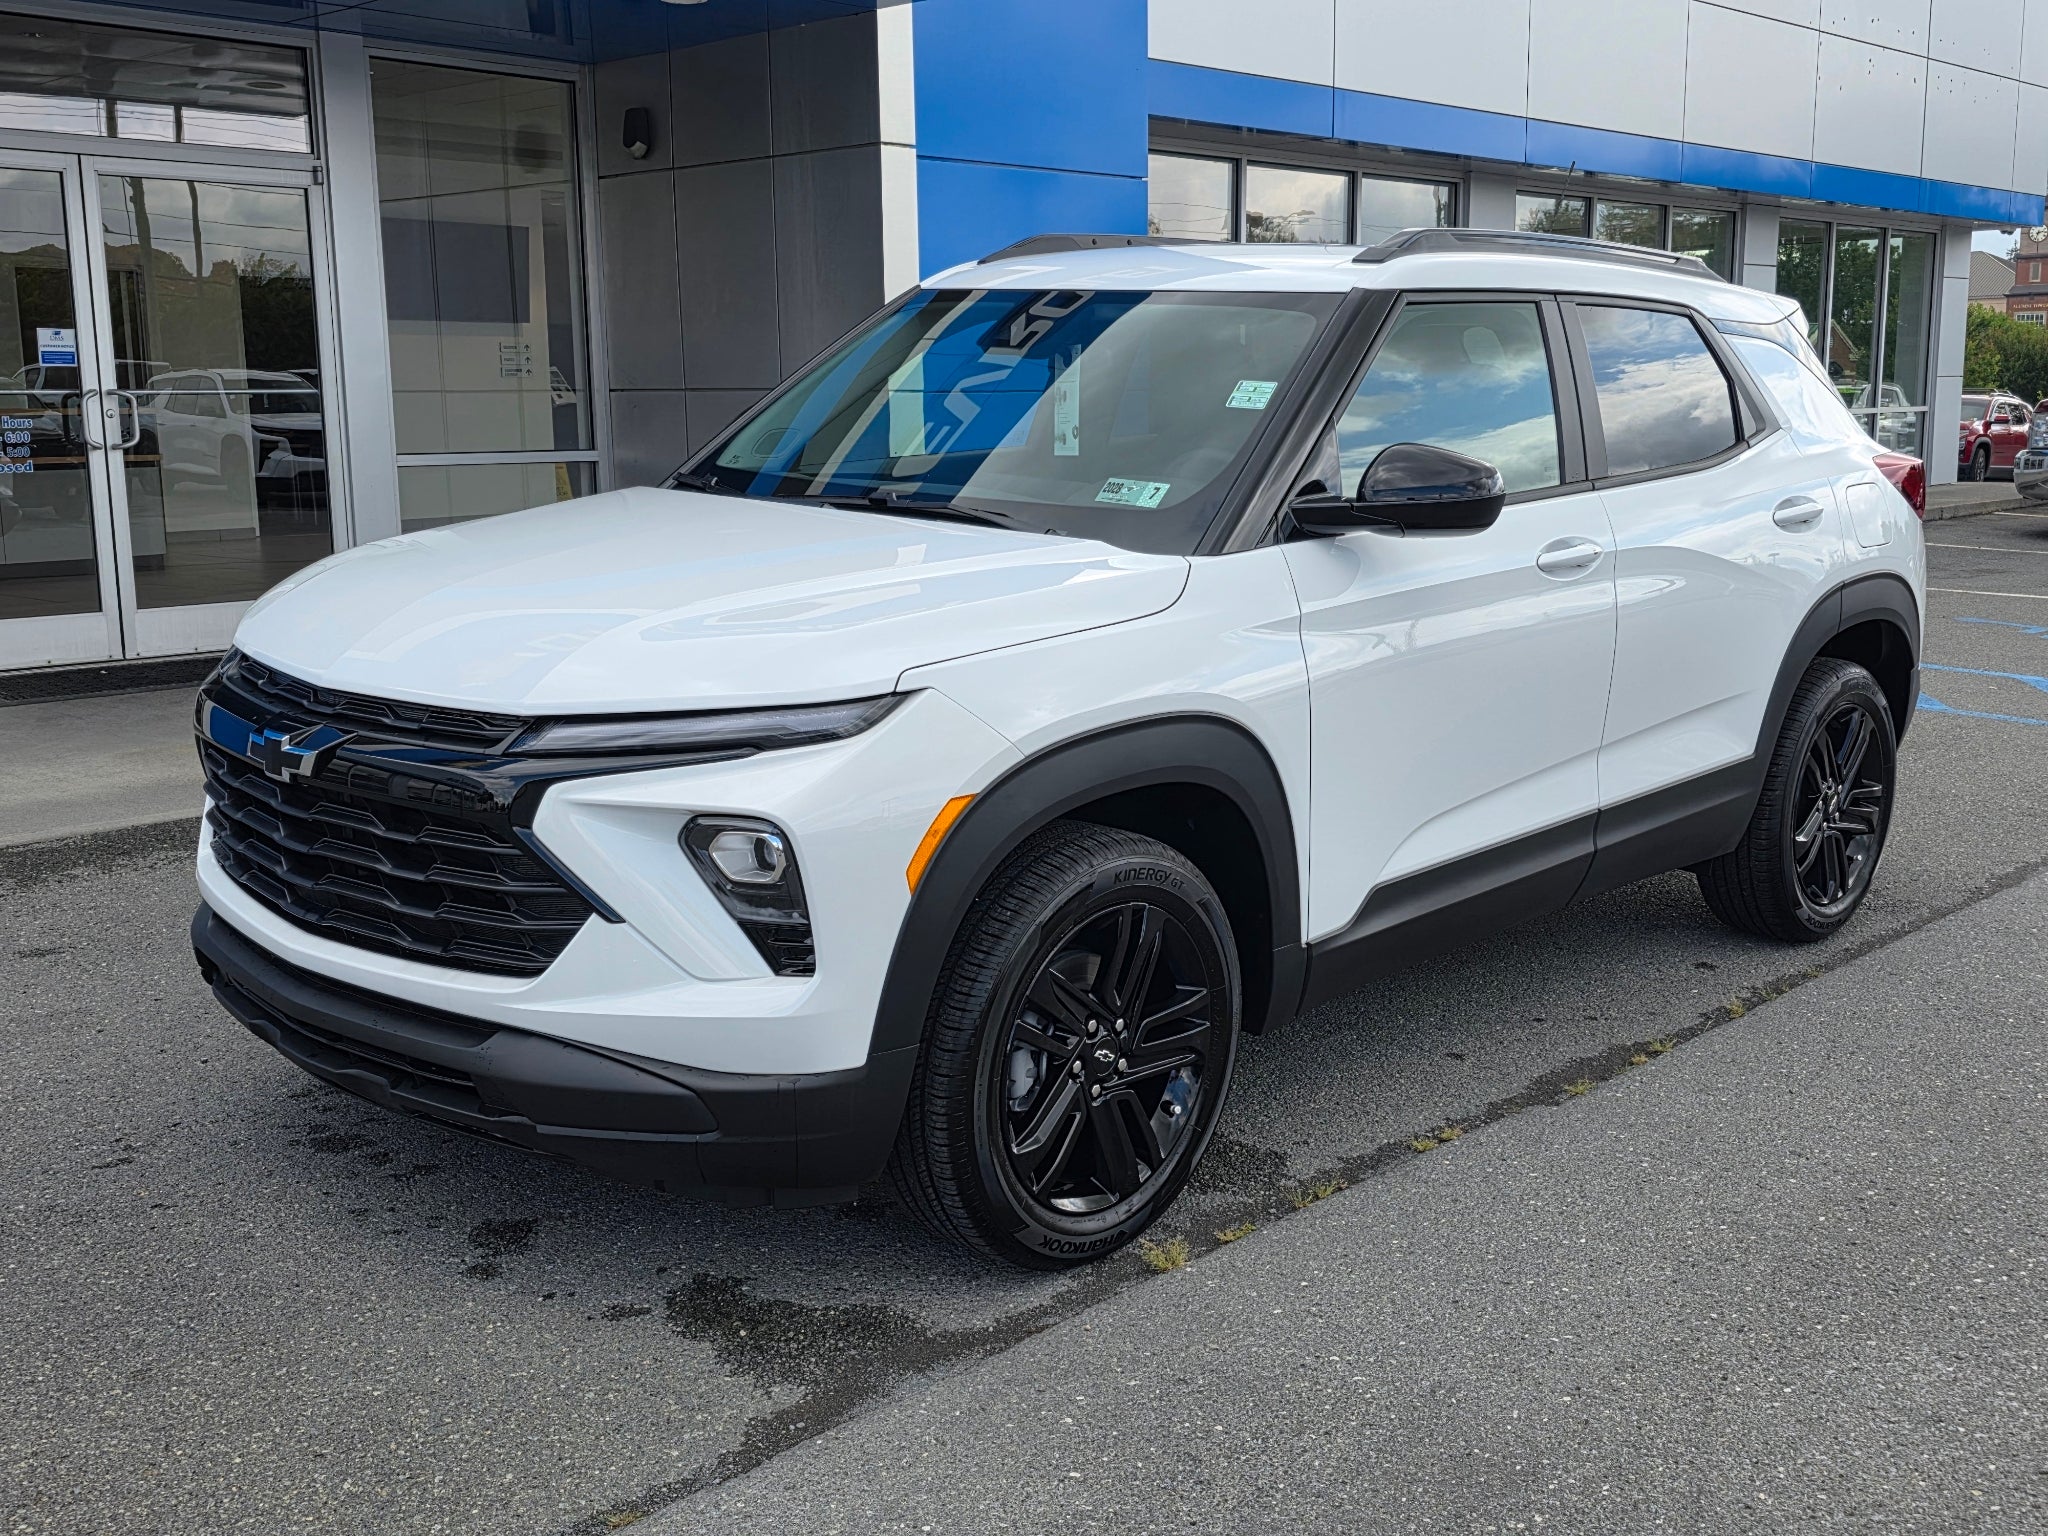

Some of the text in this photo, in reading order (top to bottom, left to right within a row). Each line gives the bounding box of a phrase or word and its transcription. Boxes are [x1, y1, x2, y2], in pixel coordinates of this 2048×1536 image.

[1, 415, 33, 428] Hours
[5, 431, 31, 443] 6:00
[6, 446, 31, 458] 5:00
[1148, 486, 1162, 500] 7
